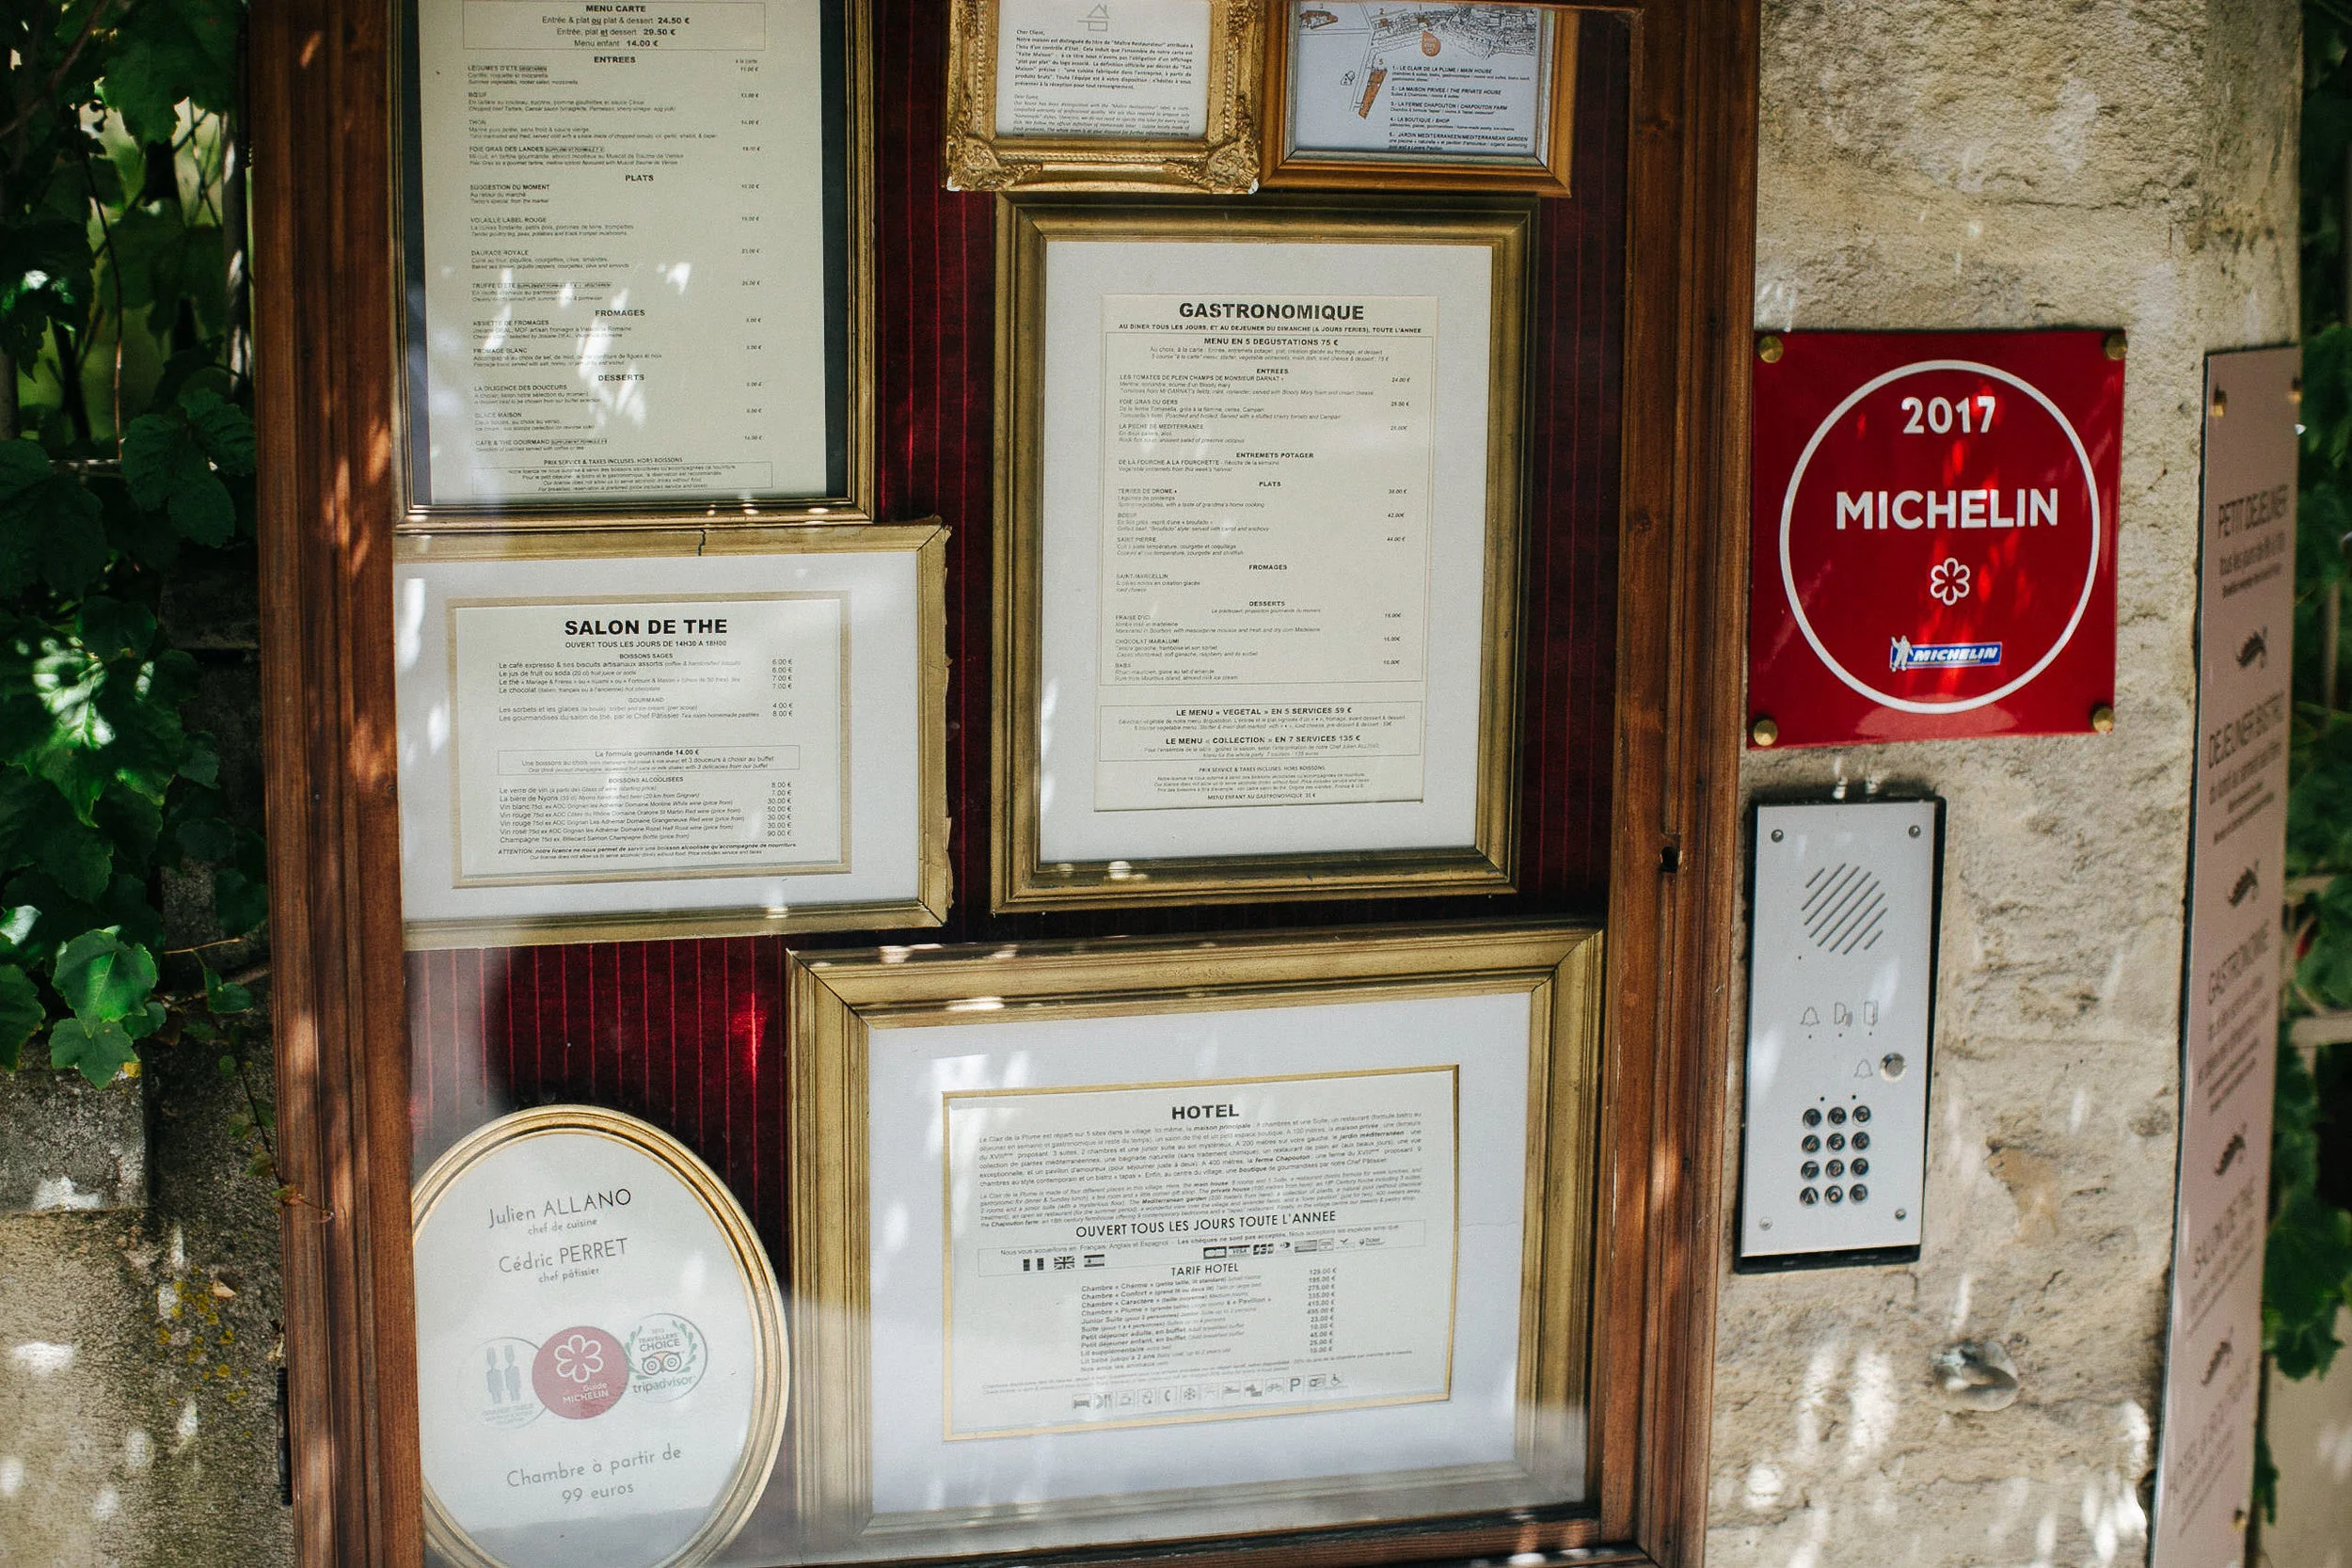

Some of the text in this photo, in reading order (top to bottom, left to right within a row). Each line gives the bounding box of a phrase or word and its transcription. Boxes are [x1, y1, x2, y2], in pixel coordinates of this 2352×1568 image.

[542, 15, 565, 24] Entrée
[576, 16, 589, 24] plat
[591, 17, 601, 25] ou
[603, 16, 617, 24] plat
[584, 28, 598, 37] plat
[599, 28, 608, 37] et
[1179, 302, 1363, 320] GASTRONOMIQUE
[1901, 395, 1995, 435] 2017
[1836, 488, 2058, 530] MICHELIN
[564, 619, 726, 635] SALON DE THE
[1914, 646, 1998, 662] MICHELIN
[633, 749, 673, 757] gourmande
[1171, 1103, 1239, 1119] HOTEL
[488, 1188, 631, 1228] Julien ALLANO
[528, 1218, 597, 1235] chef de cuisine
[1075, 1210, 1335, 1238] OUVERT TOUS LES JOURS TOUTE L'ANNEE
[499, 1237, 628, 1273] Cédric PERRET
[1171, 1262, 1238, 1275] TARIF HOTEL
[538, 1271, 559, 1283] chef
[640, 1338, 681, 1352] CHOICE
[632, 1376, 692, 1394] tripadvisor
[563, 1390, 610, 1403] MICHELIN
[506, 1443, 681, 1488] Chambre à partir de
[562, 1483, 634, 1504] 99 euros
